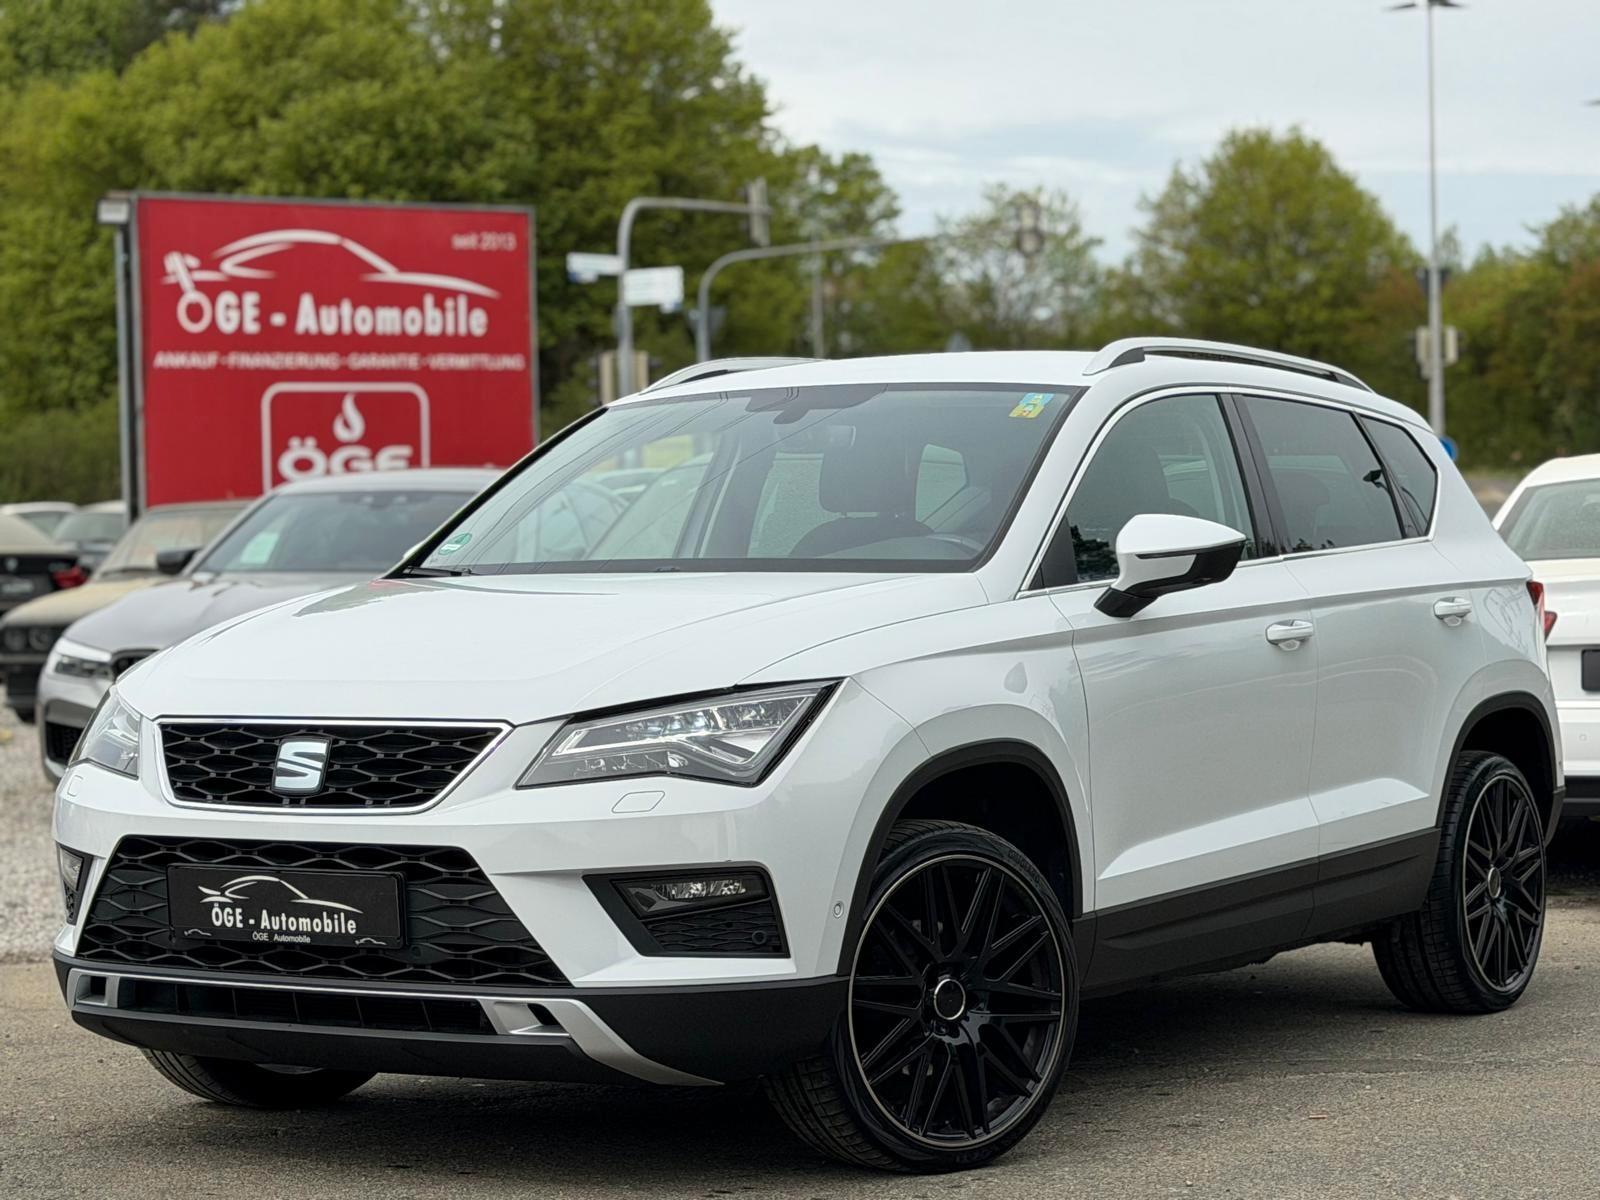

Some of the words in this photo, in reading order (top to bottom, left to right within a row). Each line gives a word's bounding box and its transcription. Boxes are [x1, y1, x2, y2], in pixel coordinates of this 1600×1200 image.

[451, 232, 478, 251] seit
[295, 292, 488, 337] Automobile
[211, 902, 244, 929] ÖGE
[260, 909, 357, 935] Automobile
[273, 933, 311, 943] Automobile
